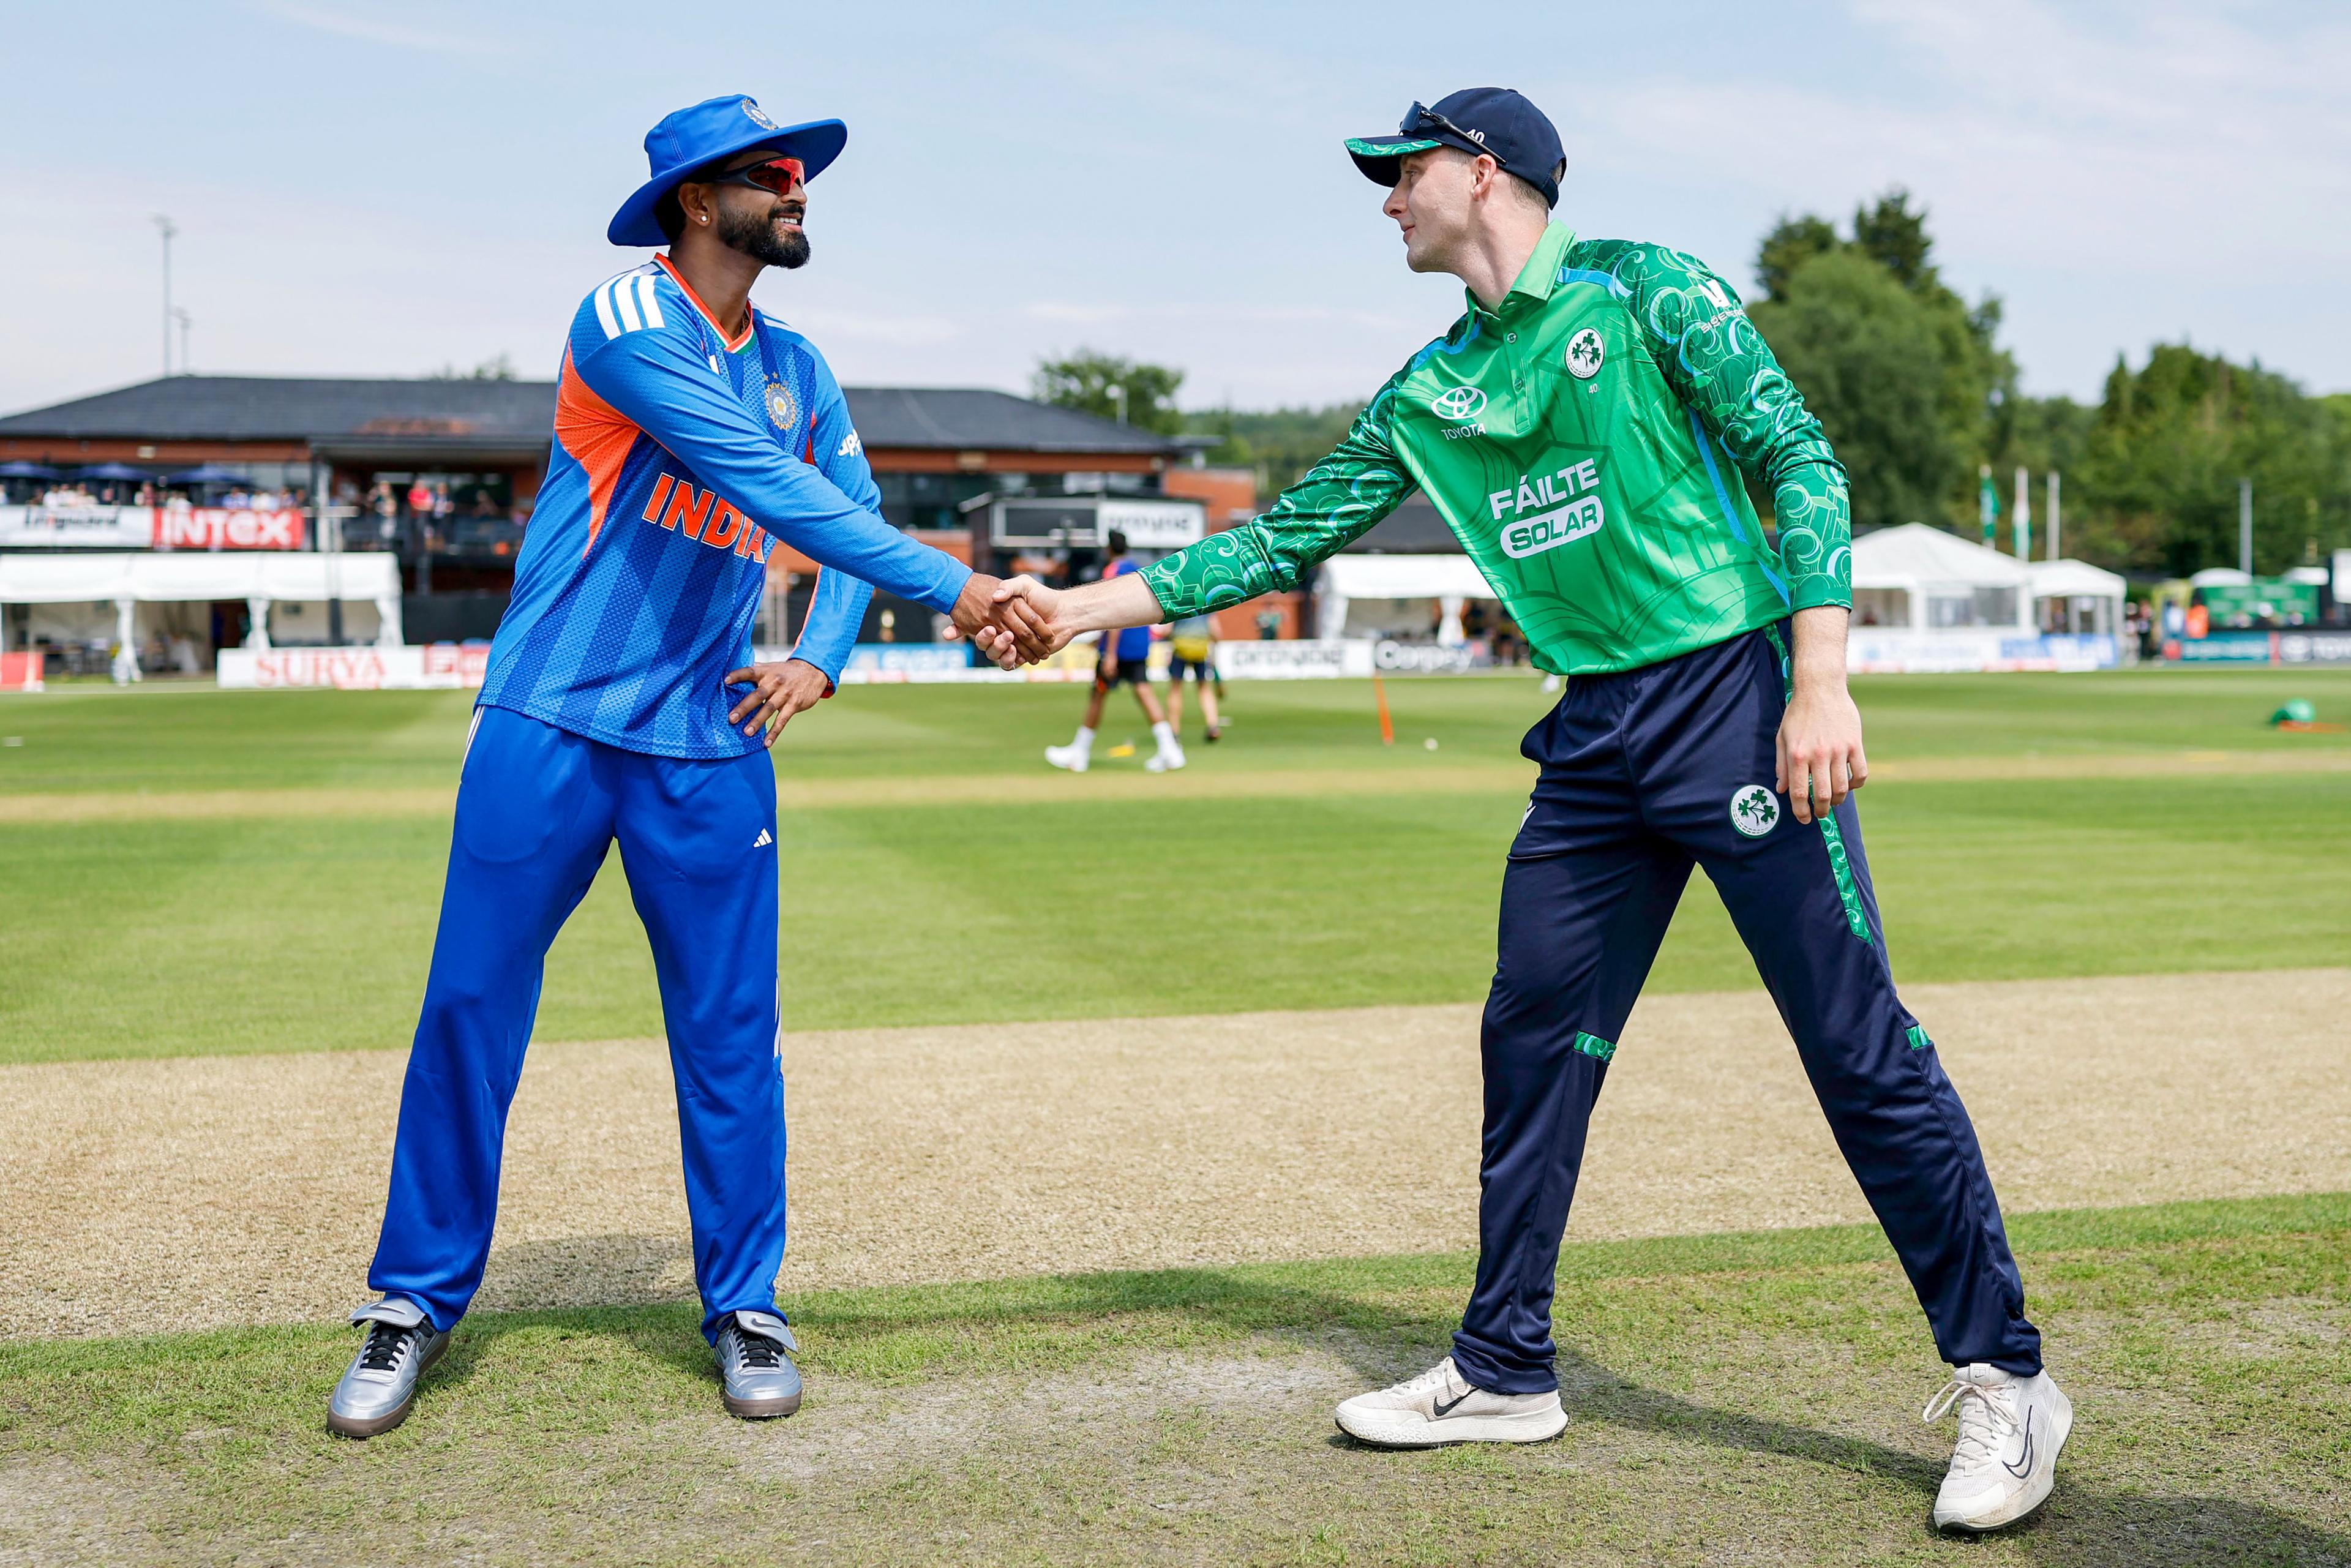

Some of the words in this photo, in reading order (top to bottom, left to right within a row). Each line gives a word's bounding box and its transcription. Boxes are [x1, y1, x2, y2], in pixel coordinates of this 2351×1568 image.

[1588, 383, 1598, 394] 40
[1441, 422, 1487, 441] TOYOTA
[1489, 457, 1600, 520] FÁILTE
[642, 472, 765, 564] INDIA
[1509, 502, 1598, 552] SOLAR
[255, 651, 387, 687] SURYA
